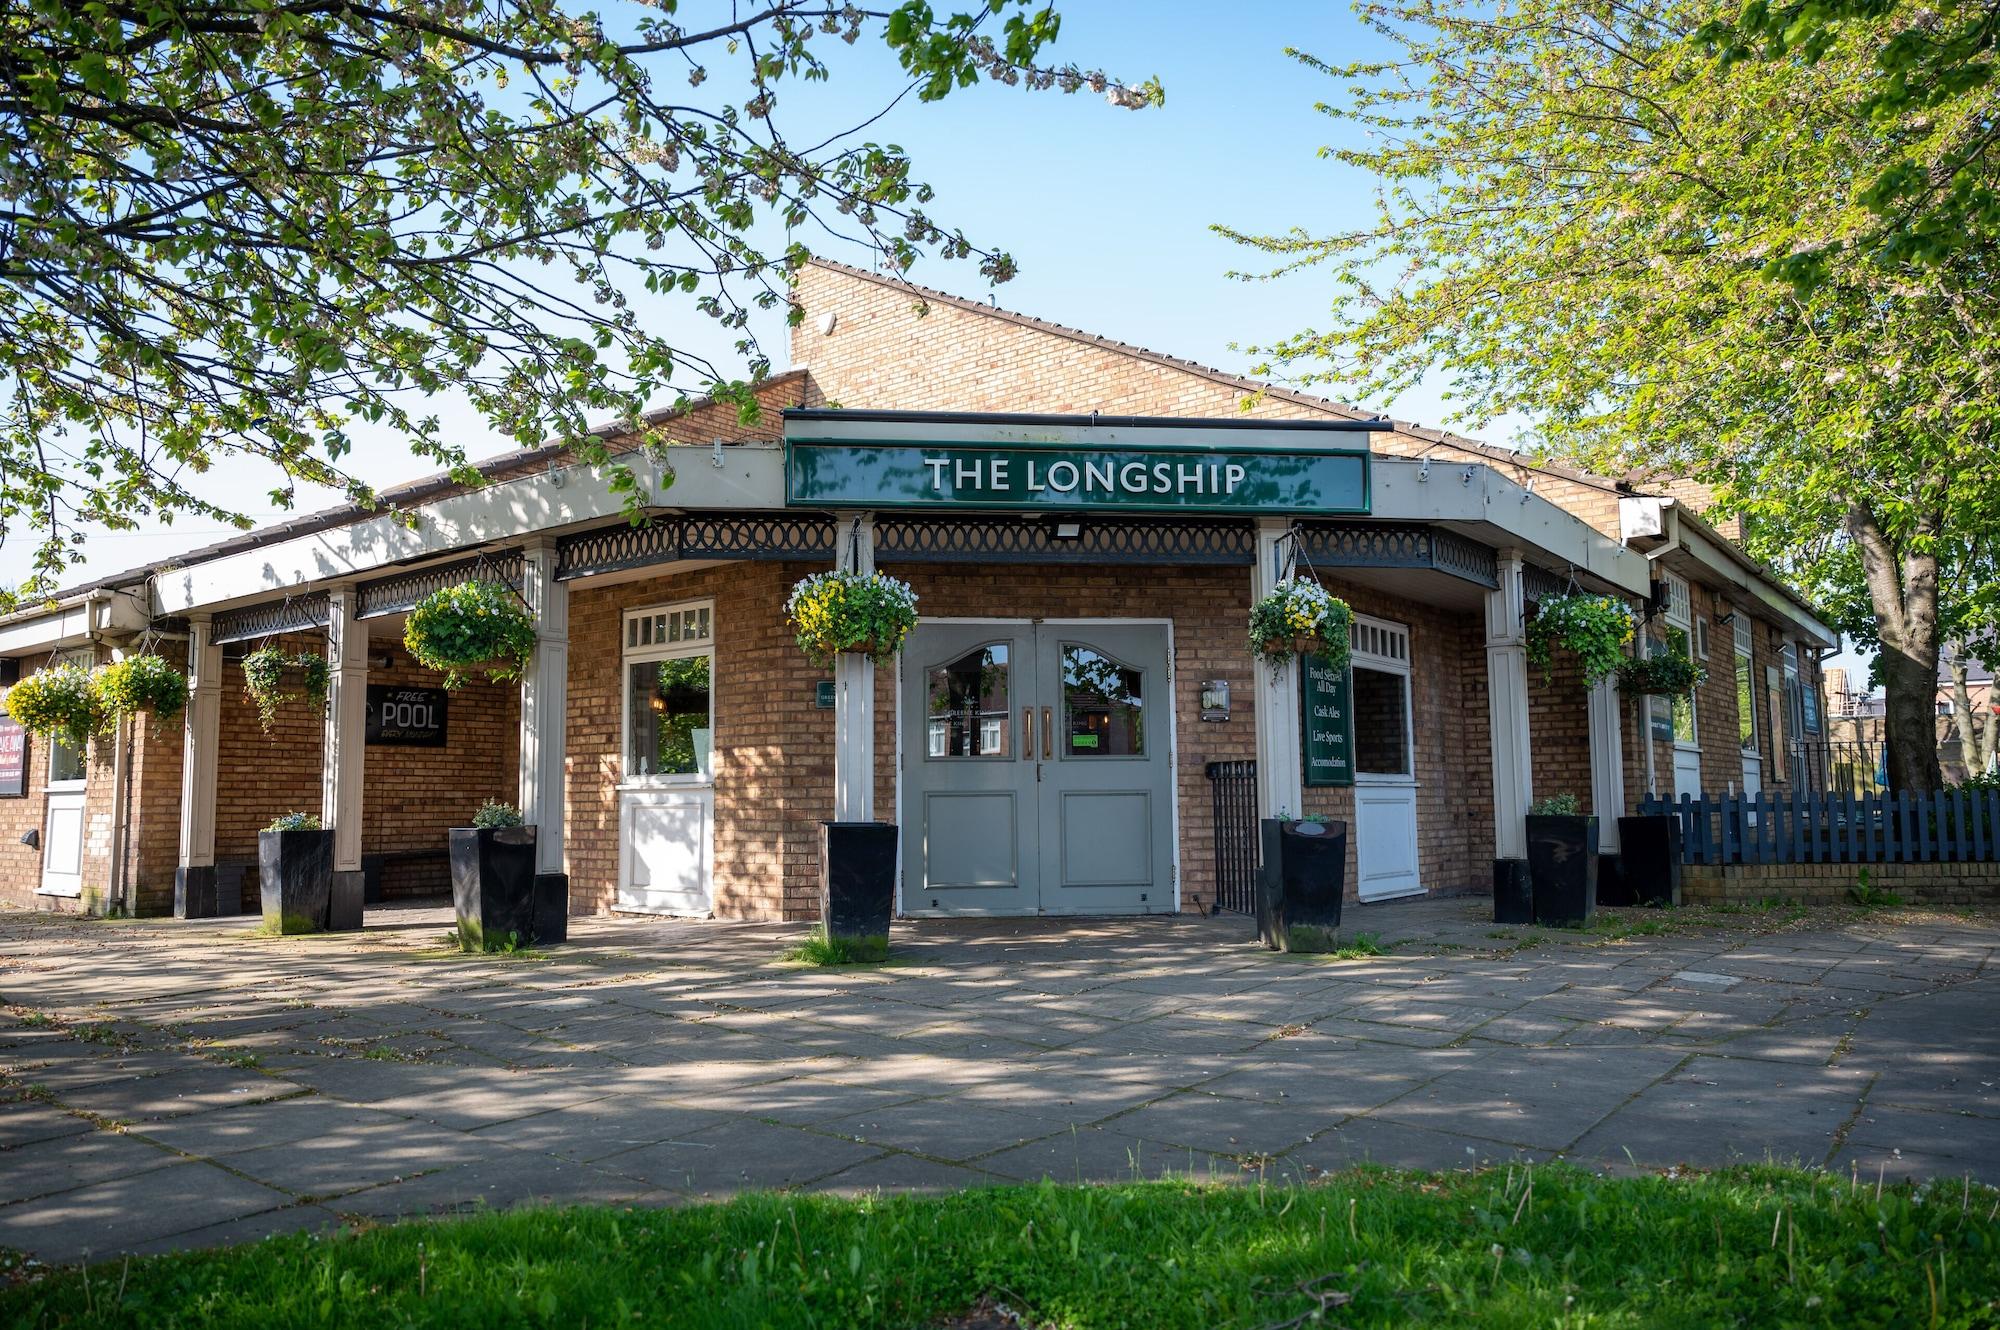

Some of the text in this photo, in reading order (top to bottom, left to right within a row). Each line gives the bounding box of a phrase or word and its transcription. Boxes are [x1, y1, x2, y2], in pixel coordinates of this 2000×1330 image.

[924, 458, 1246, 494] THE LONGSHIP
[1310, 667, 1324, 679] Food
[1317, 680, 1336, 696] All Day
[396, 692, 428, 701] FREE
[382, 702, 439, 728] POOL
[1314, 705, 1340, 718] Cask Ales
[1313, 730, 1343, 745] Live Sports
